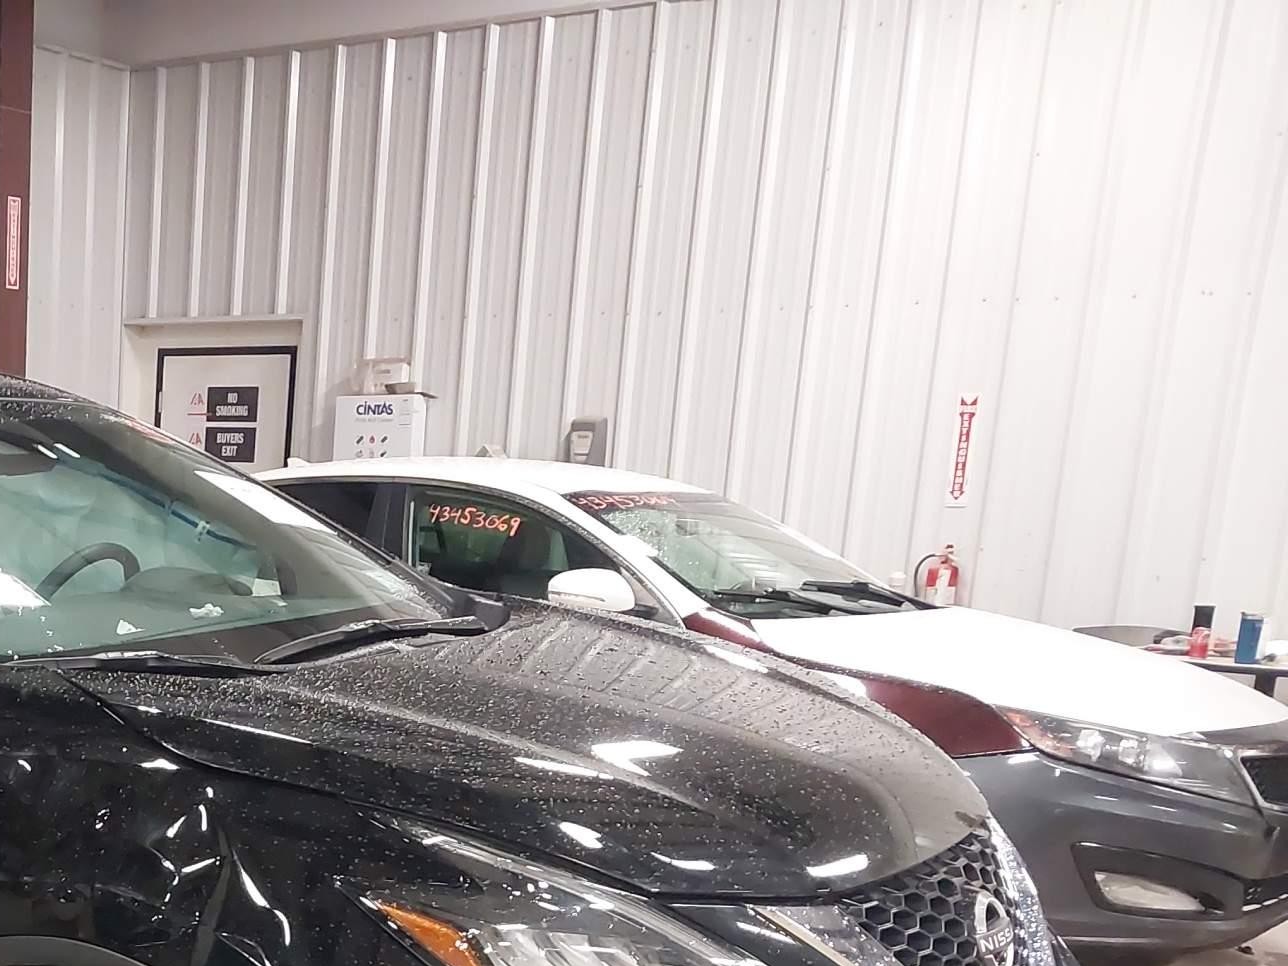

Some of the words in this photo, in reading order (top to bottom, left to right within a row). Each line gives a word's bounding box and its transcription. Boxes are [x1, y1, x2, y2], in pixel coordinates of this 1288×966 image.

[227, 392, 238, 404] NO
[215, 405, 249, 417] SMOKING
[216, 432, 245, 444] BUYERS
[221, 445, 238, 457] EXIT
[429, 503, 521, 537] 43453069
[979, 927, 1012, 953] NISS
